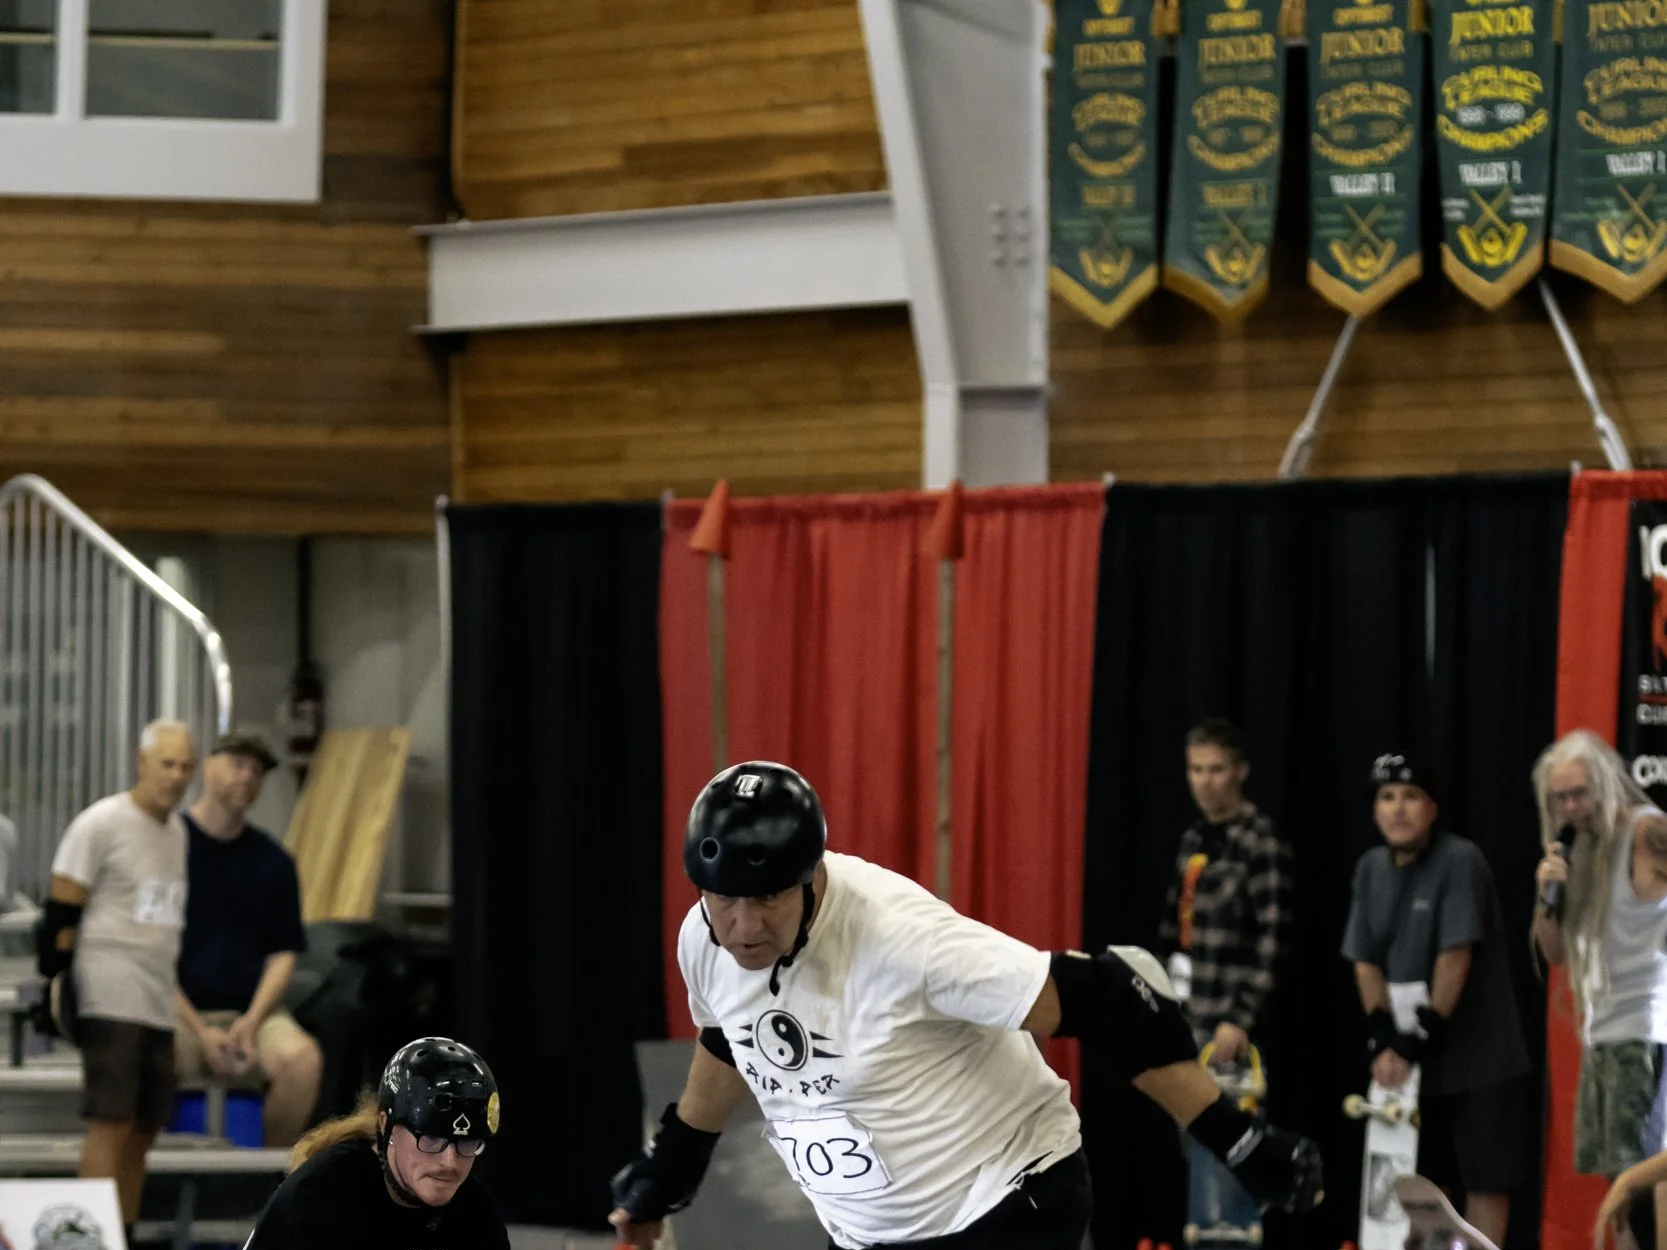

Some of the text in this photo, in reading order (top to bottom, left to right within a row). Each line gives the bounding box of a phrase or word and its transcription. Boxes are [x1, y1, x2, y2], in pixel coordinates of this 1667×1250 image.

[1450, 6, 1534, 46] JUNIOR
[1584, 56, 1667, 90] CURLIN
[1576, 109, 1667, 145] CHAMPIO
